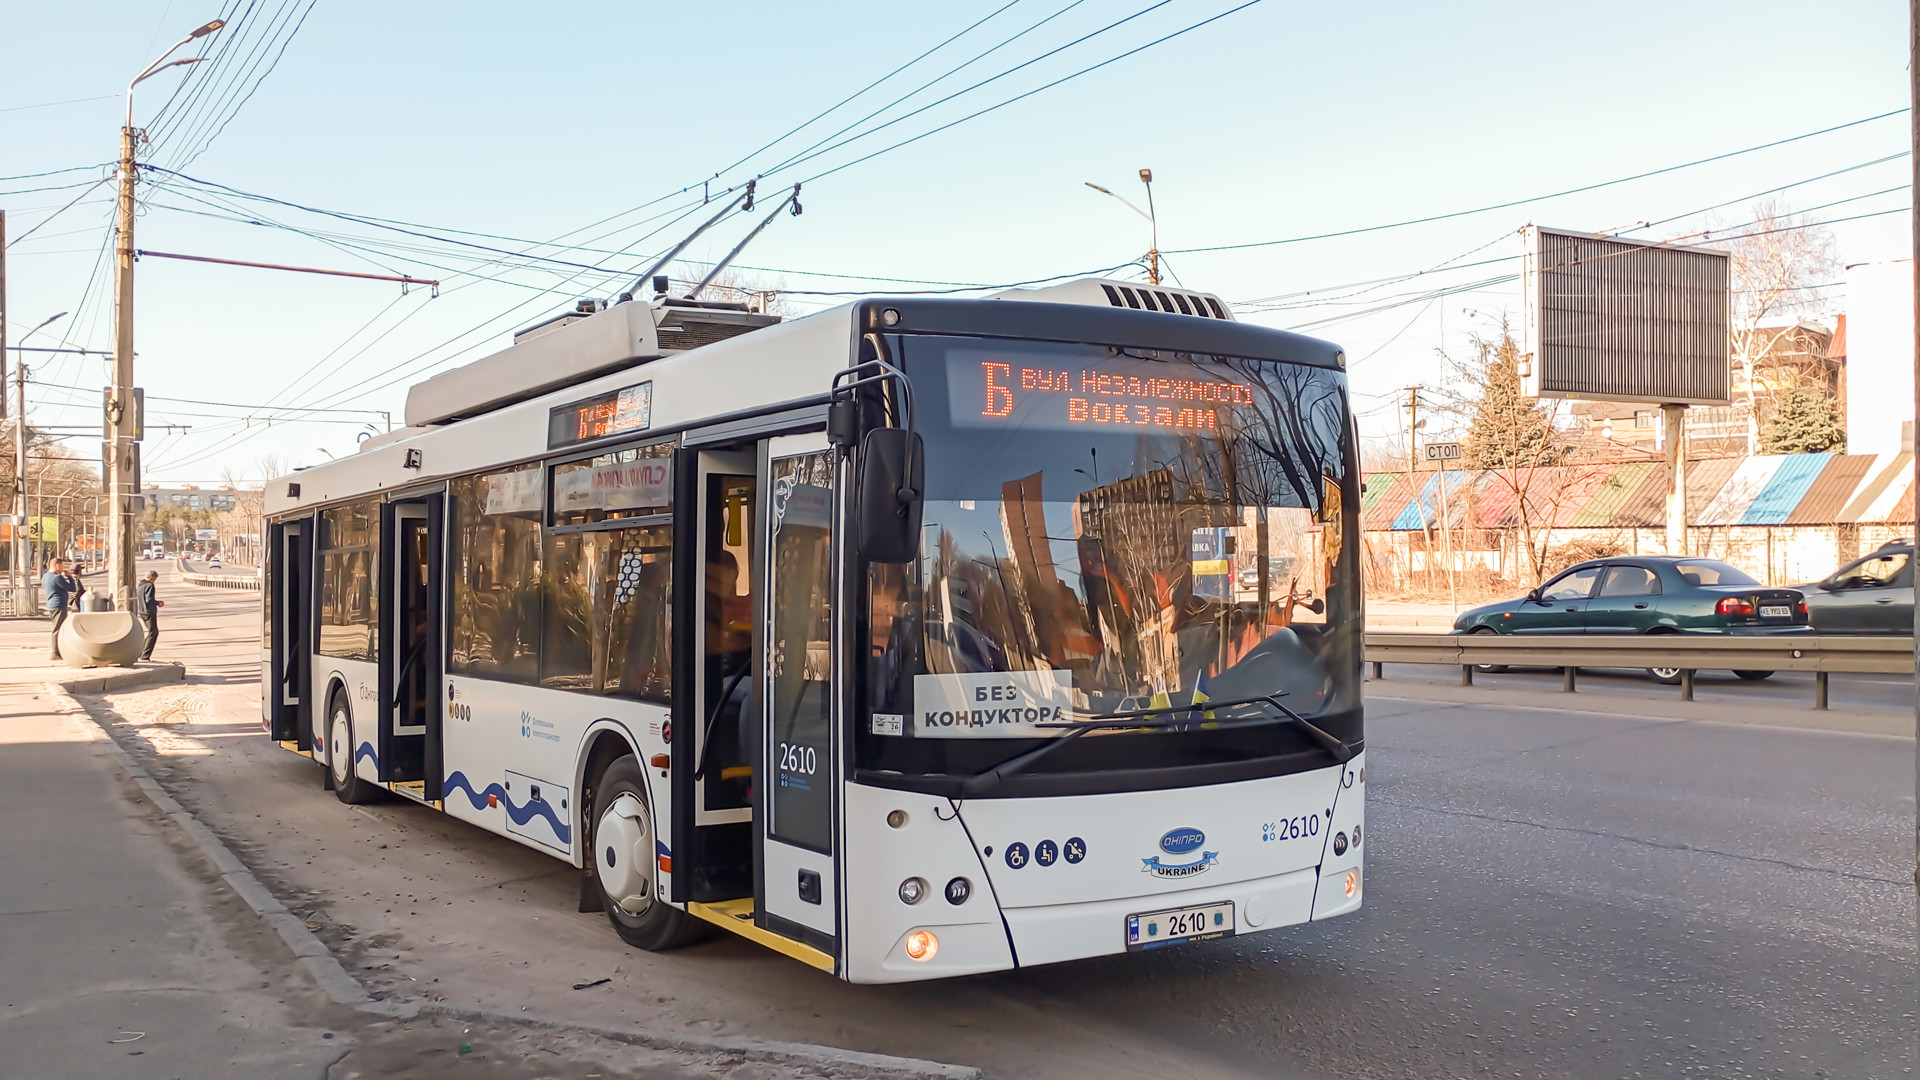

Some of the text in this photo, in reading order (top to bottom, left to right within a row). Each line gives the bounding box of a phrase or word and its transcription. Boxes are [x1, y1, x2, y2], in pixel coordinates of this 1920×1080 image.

[981, 361, 1013, 417] Б
[1082, 369, 1253, 405] Незалежності
[1068, 397, 1215, 428] Вокзали
[1428, 444, 1458, 458] СТОП
[975, 685, 1017, 702] БЕЗ
[925, 706, 1066, 728] КОНДУКТОРА
[780, 742, 816, 775] 2610
[1279, 813, 1319, 841] 2610
[1157, 862, 1205, 876] UKRAINE
[1169, 912, 1205, 936] 2610
[1130, 933, 1138, 941] UA
